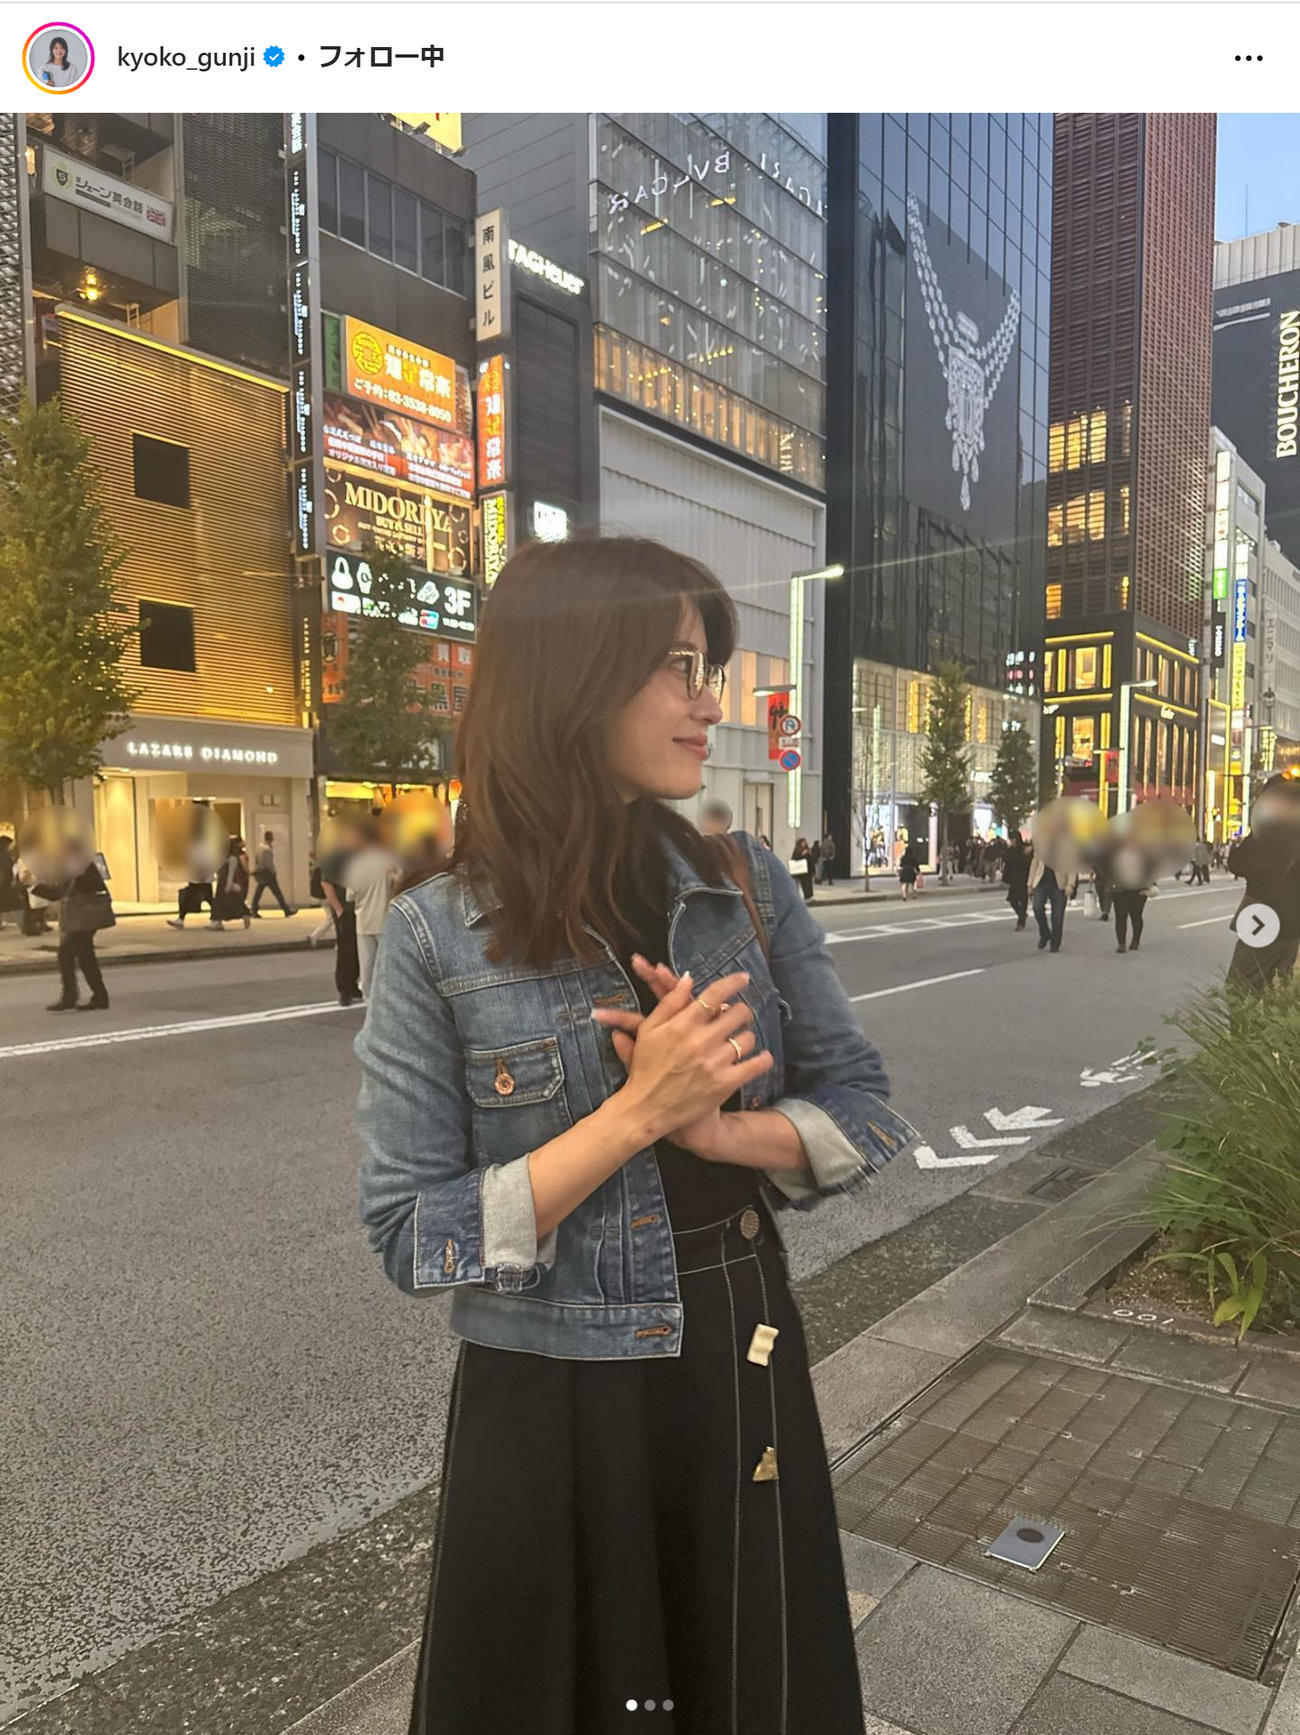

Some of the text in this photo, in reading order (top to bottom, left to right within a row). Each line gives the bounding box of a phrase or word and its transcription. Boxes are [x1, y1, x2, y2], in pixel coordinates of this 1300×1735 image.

[482, 225, 495, 327] 南風ビル
[1276, 310, 1300, 459] BOUCHERON
[345, 482, 453, 533] MIDORIYA
[444, 586, 472, 616] 3F
[127, 741, 279, 764] LAZARE DIAMOND
